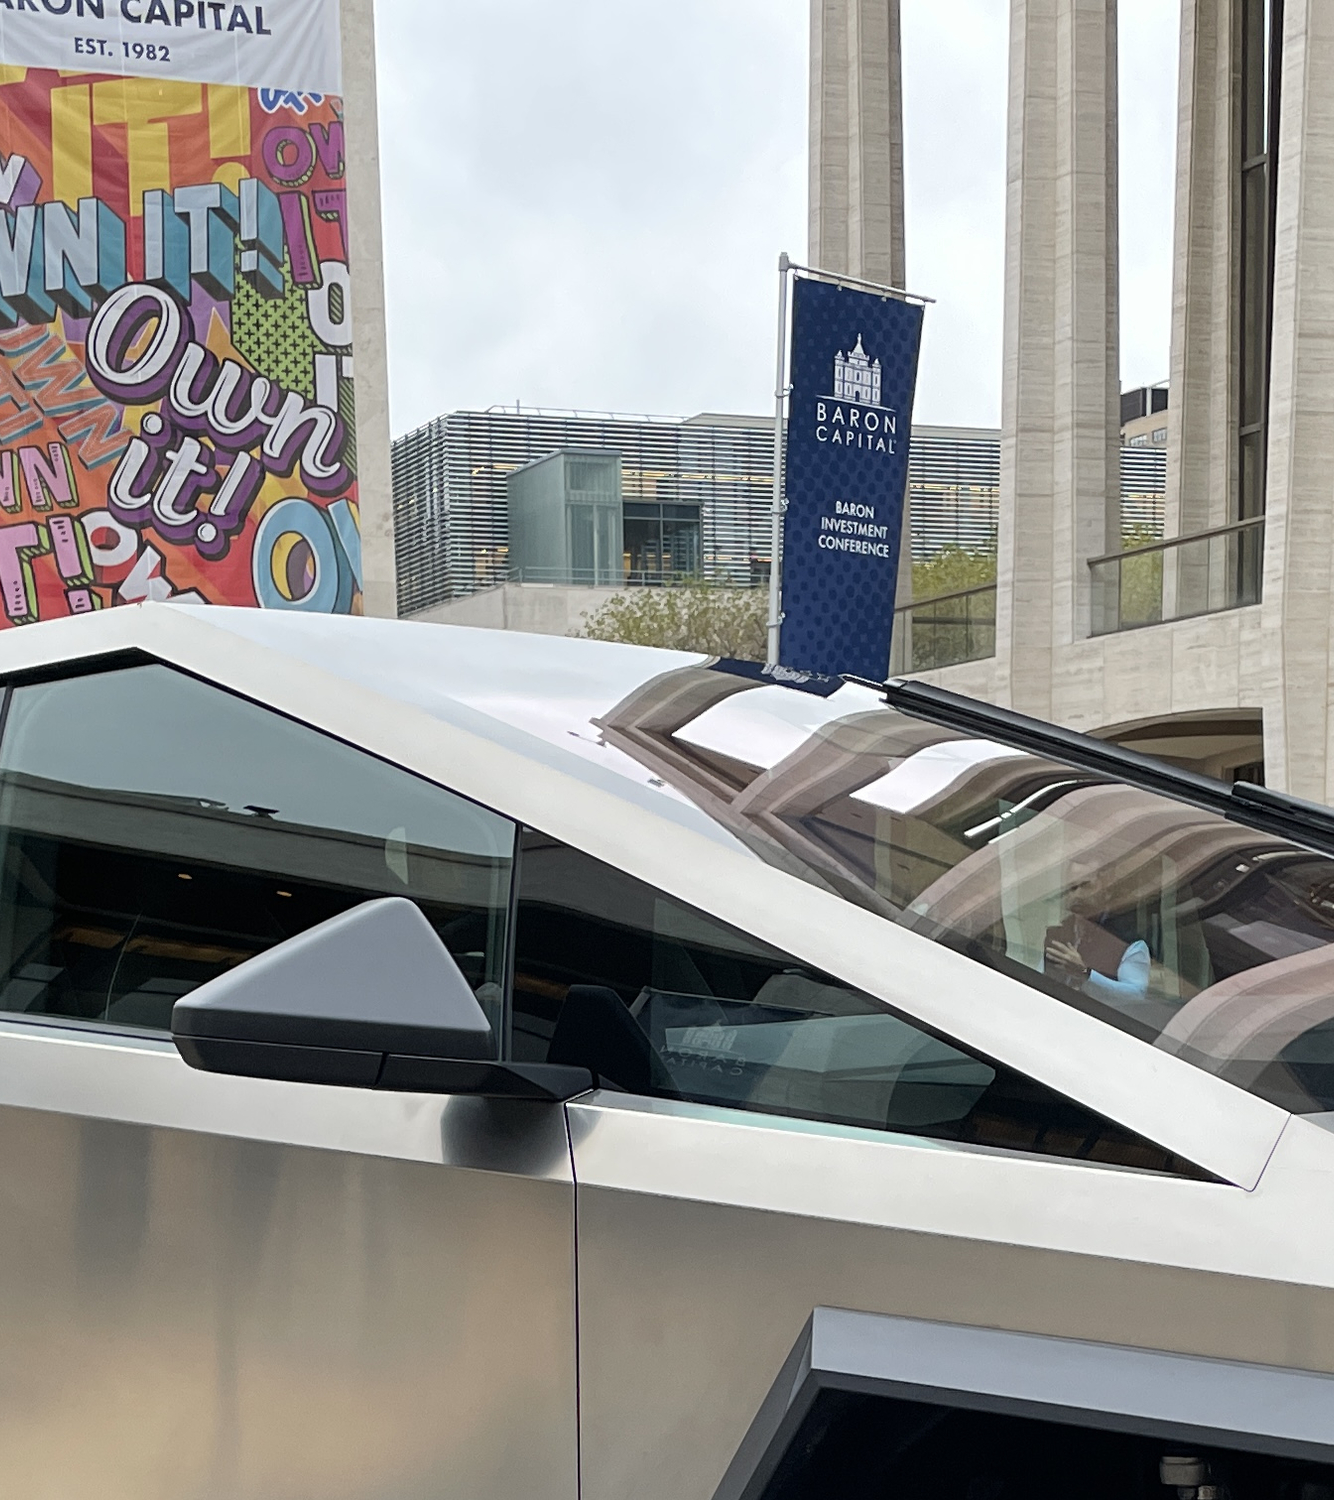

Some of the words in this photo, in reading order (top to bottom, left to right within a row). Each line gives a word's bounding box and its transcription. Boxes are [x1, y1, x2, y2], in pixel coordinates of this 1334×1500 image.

[120, 0, 272, 36] CAPITAL
[74, 36, 113, 57] EST.
[122, 41, 171, 62] 1982
[143, 177, 263, 283] IT!
[88, 281, 341, 478] Own
[816, 401, 897, 435] BARON
[816, 425, 896, 454] CAPITAL
[109, 412, 253, 544] it!
[835, 500, 875, 520] BARON
[820, 516, 888, 540] INVESTMENT
[818, 535, 890, 559] CONFERENCE
